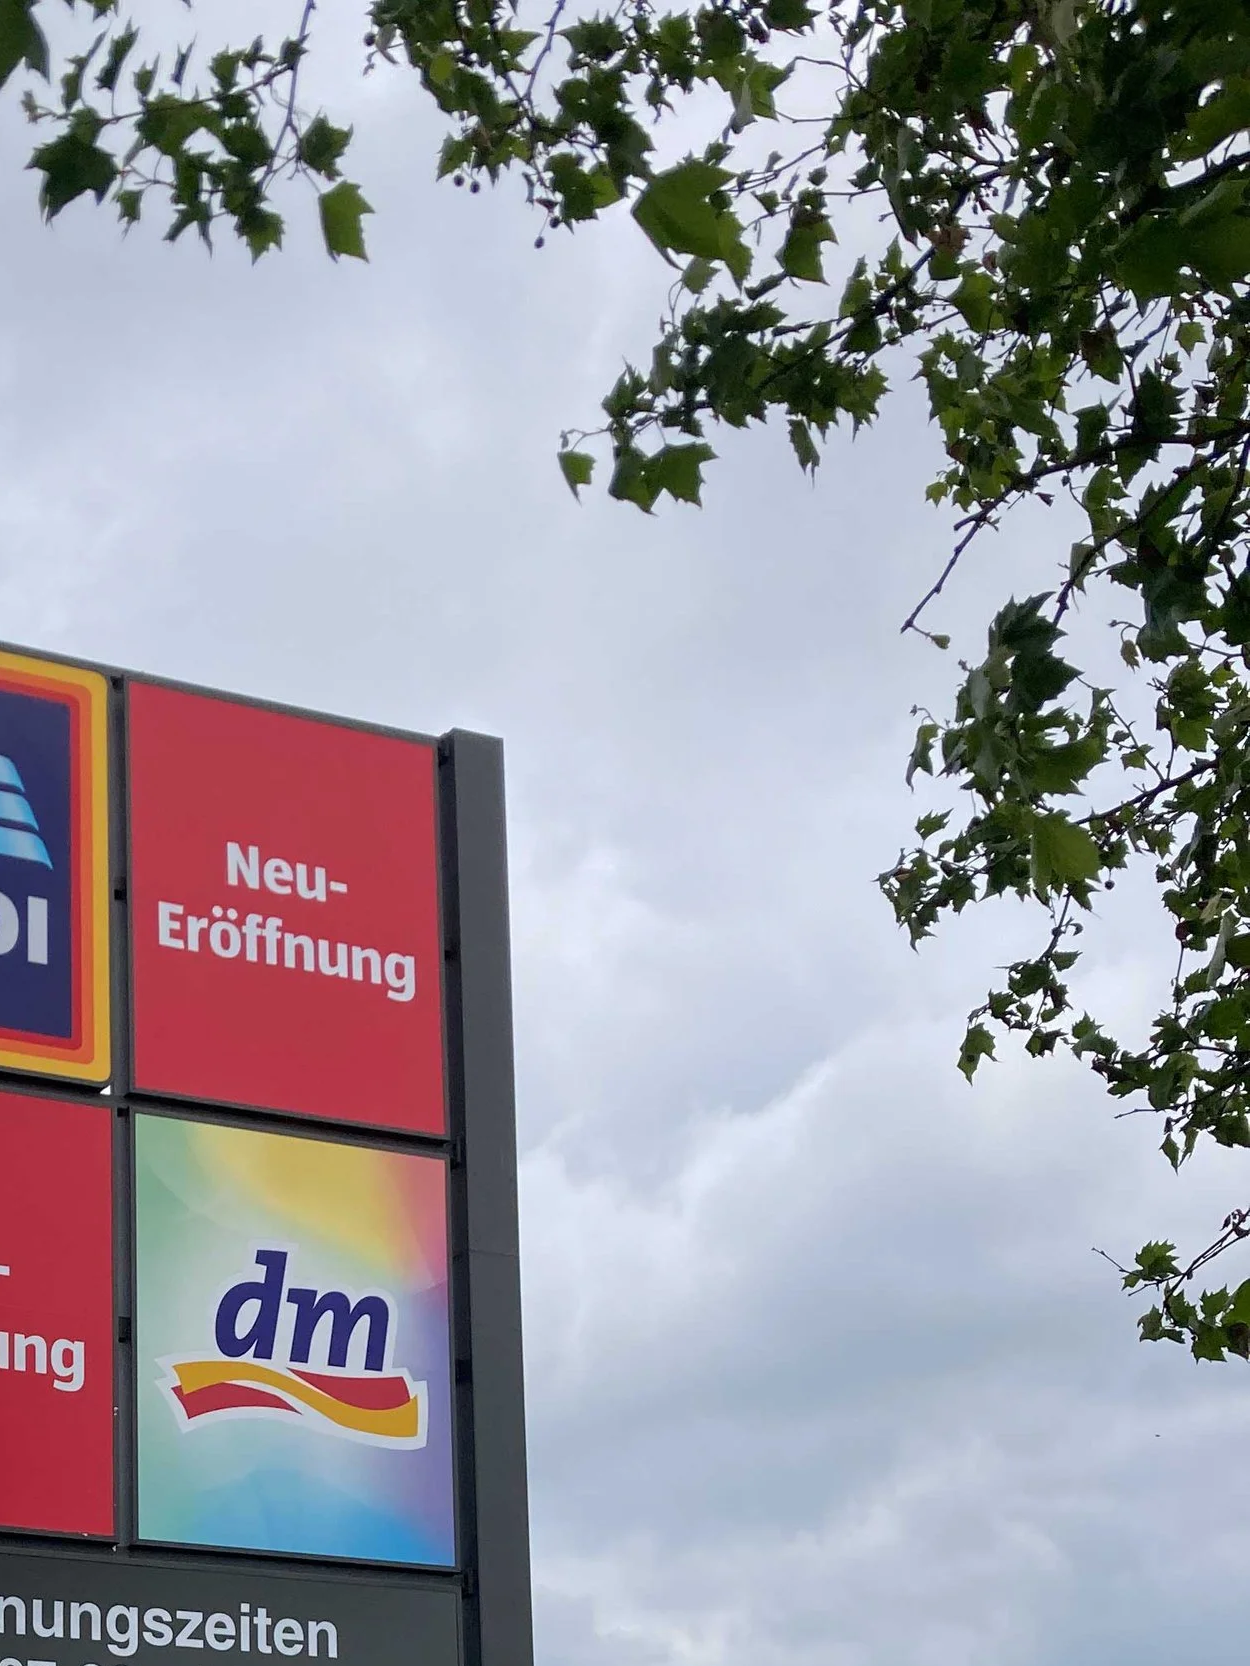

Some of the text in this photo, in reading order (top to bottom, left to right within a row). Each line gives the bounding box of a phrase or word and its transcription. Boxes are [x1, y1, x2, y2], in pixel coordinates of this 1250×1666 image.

[226, 841, 348, 903] Neu-
[157, 900, 417, 1003] Eröffnung
[215, 1248, 390, 1373] dm
